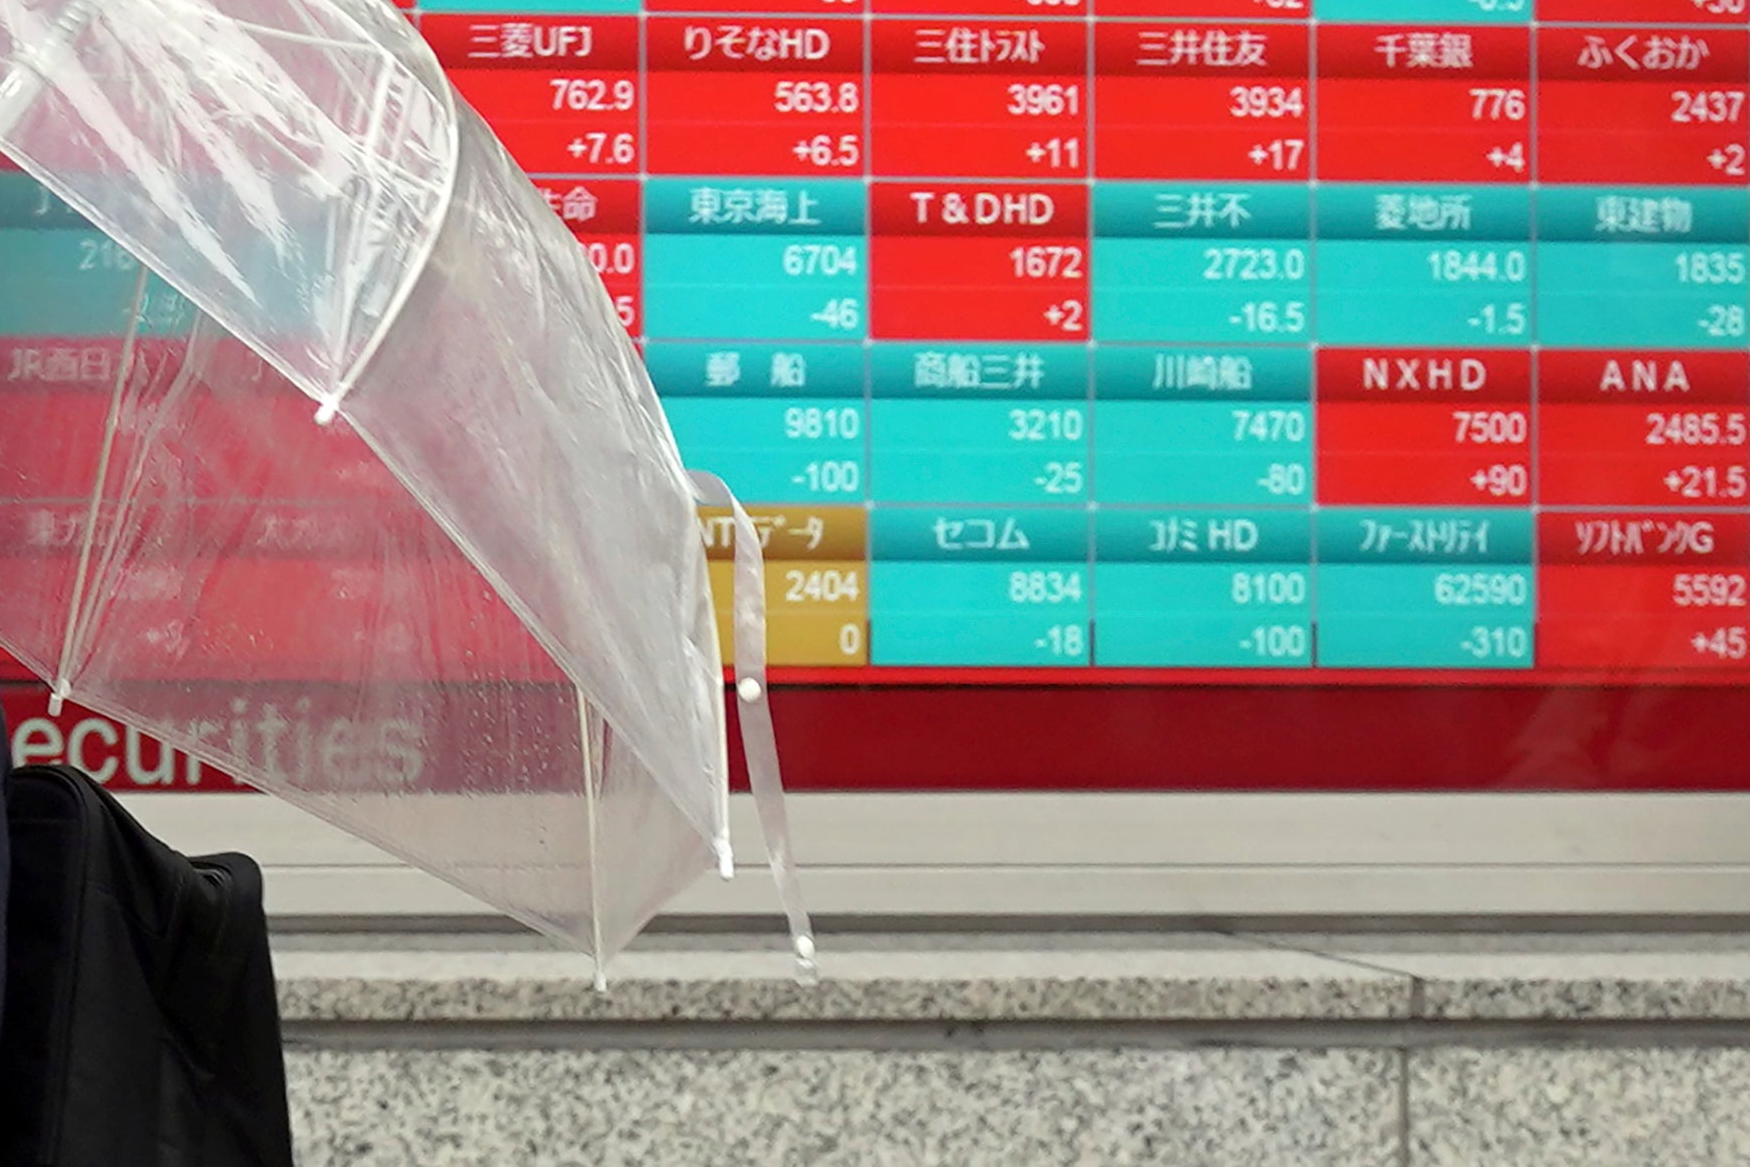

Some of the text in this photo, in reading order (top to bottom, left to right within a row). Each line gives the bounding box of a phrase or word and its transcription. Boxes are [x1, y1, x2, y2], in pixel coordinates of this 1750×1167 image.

[465, 22, 595, 62] 三菱UFJ
[684, 24, 831, 62] りそなHD
[1138, 28, 1267, 68] 三井住友
[1374, 31, 1474, 70] 千葉銀
[1576, 33, 1711, 71] ふくおか
[773, 80, 860, 114] 563.8
[1229, 84, 1306, 119] 3934
[1670, 89, 1746, 124] 2437
[690, 185, 820, 226] 東京海上
[1152, 191, 1252, 230] 三井不
[1009, 244, 1084, 280] 1672
[1427, 248, 1526, 283] 1844.0
[809, 296, 860, 331] -46
[1231, 408, 1307, 443] 7470
[1644, 411, 1748, 447] 2485.5
[931, 516, 1031, 551] セコム
[1008, 569, 1084, 605] 8834
[1433, 571, 1528, 607] 62590
[1689, 625, 1748, 660] +45
